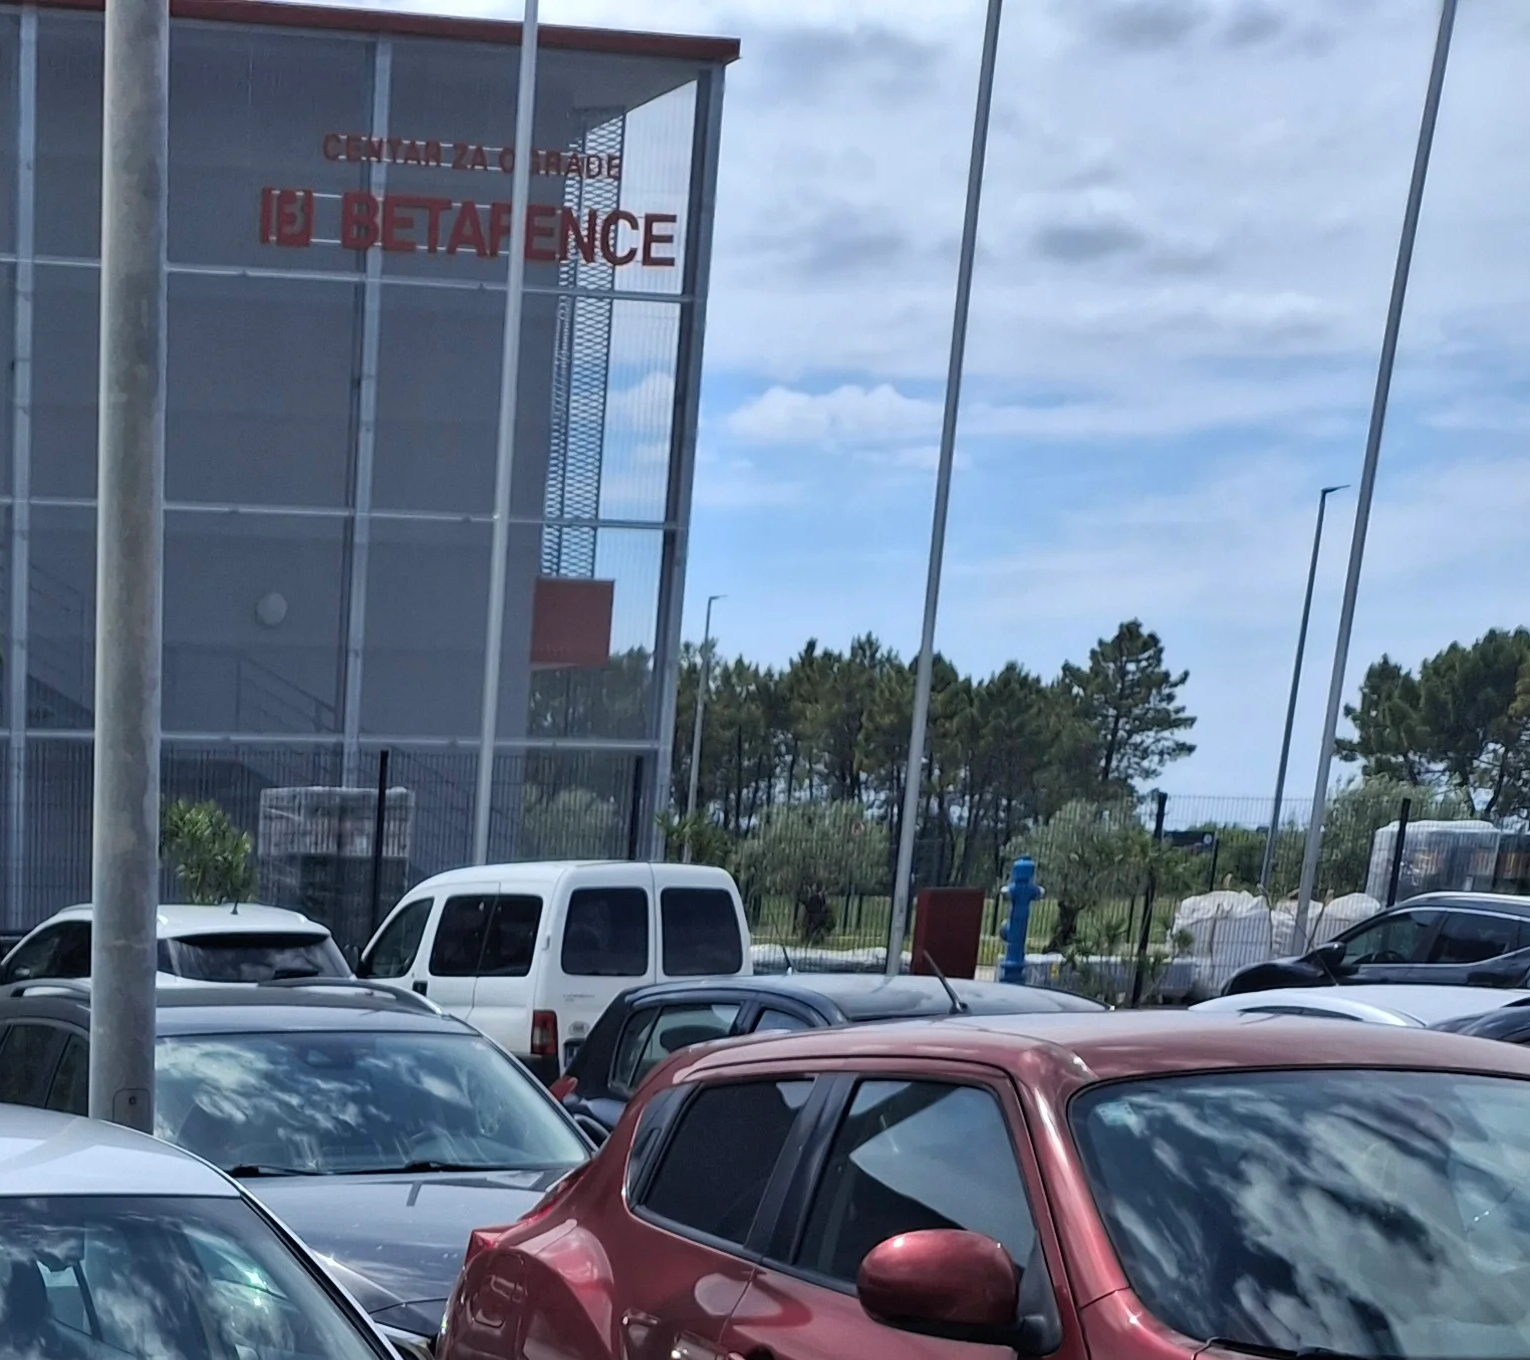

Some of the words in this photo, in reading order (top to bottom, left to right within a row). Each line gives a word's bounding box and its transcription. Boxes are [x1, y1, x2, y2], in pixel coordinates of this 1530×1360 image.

[322, 133, 442, 167] CENTAR
[452, 142, 488, 171] ZA
[342, 192, 677, 268] BETAFENCE
